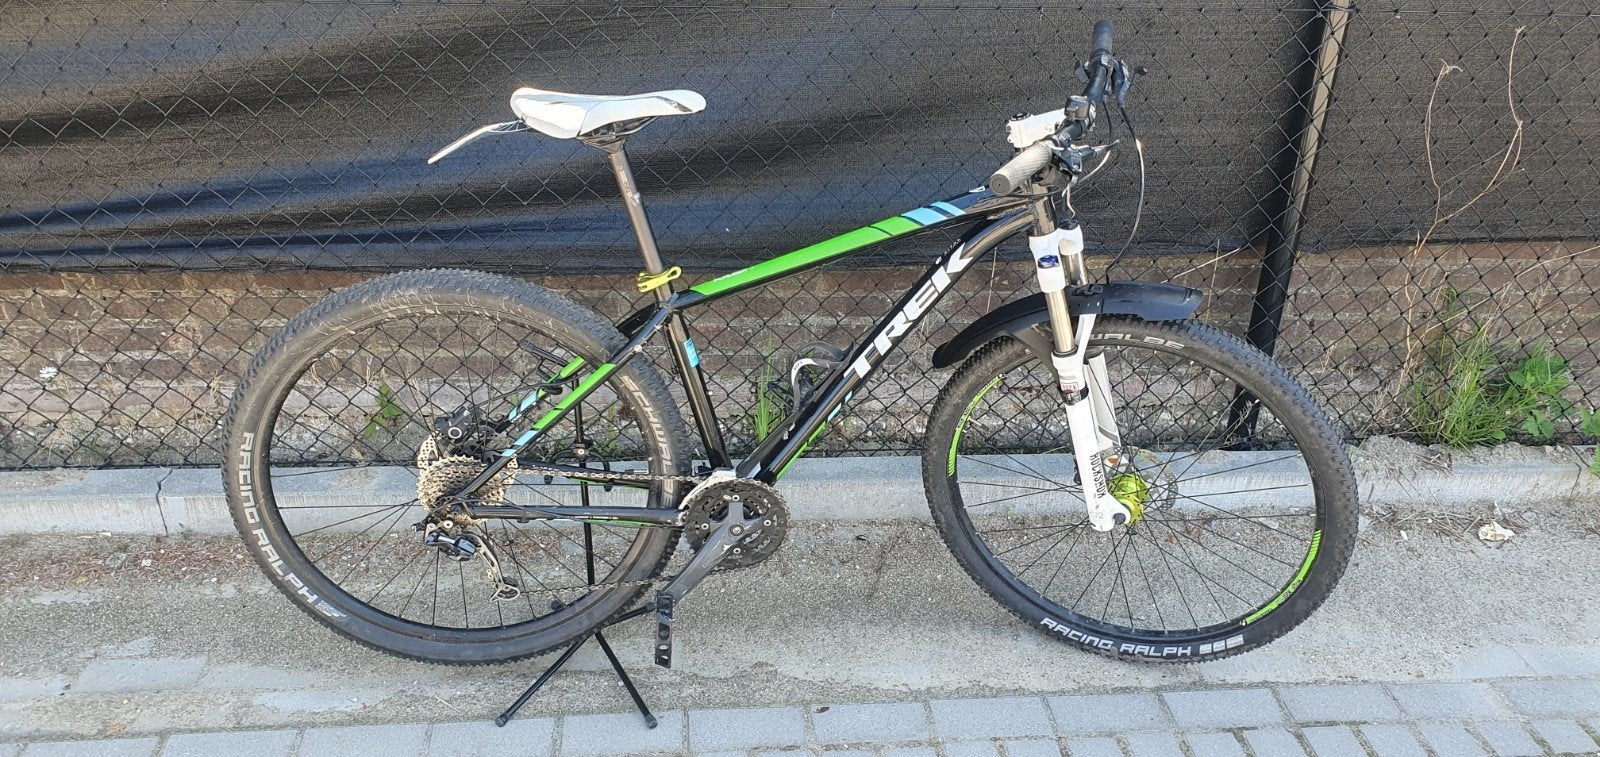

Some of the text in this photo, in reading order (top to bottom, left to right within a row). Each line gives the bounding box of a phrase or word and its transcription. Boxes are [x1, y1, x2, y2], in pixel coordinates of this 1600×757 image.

[843, 242, 974, 379] TREK
[238, 432, 319, 604] RACING RALPH
[1040, 617, 1114, 650] RACING
[1120, 644, 1191, 657] RALPH
